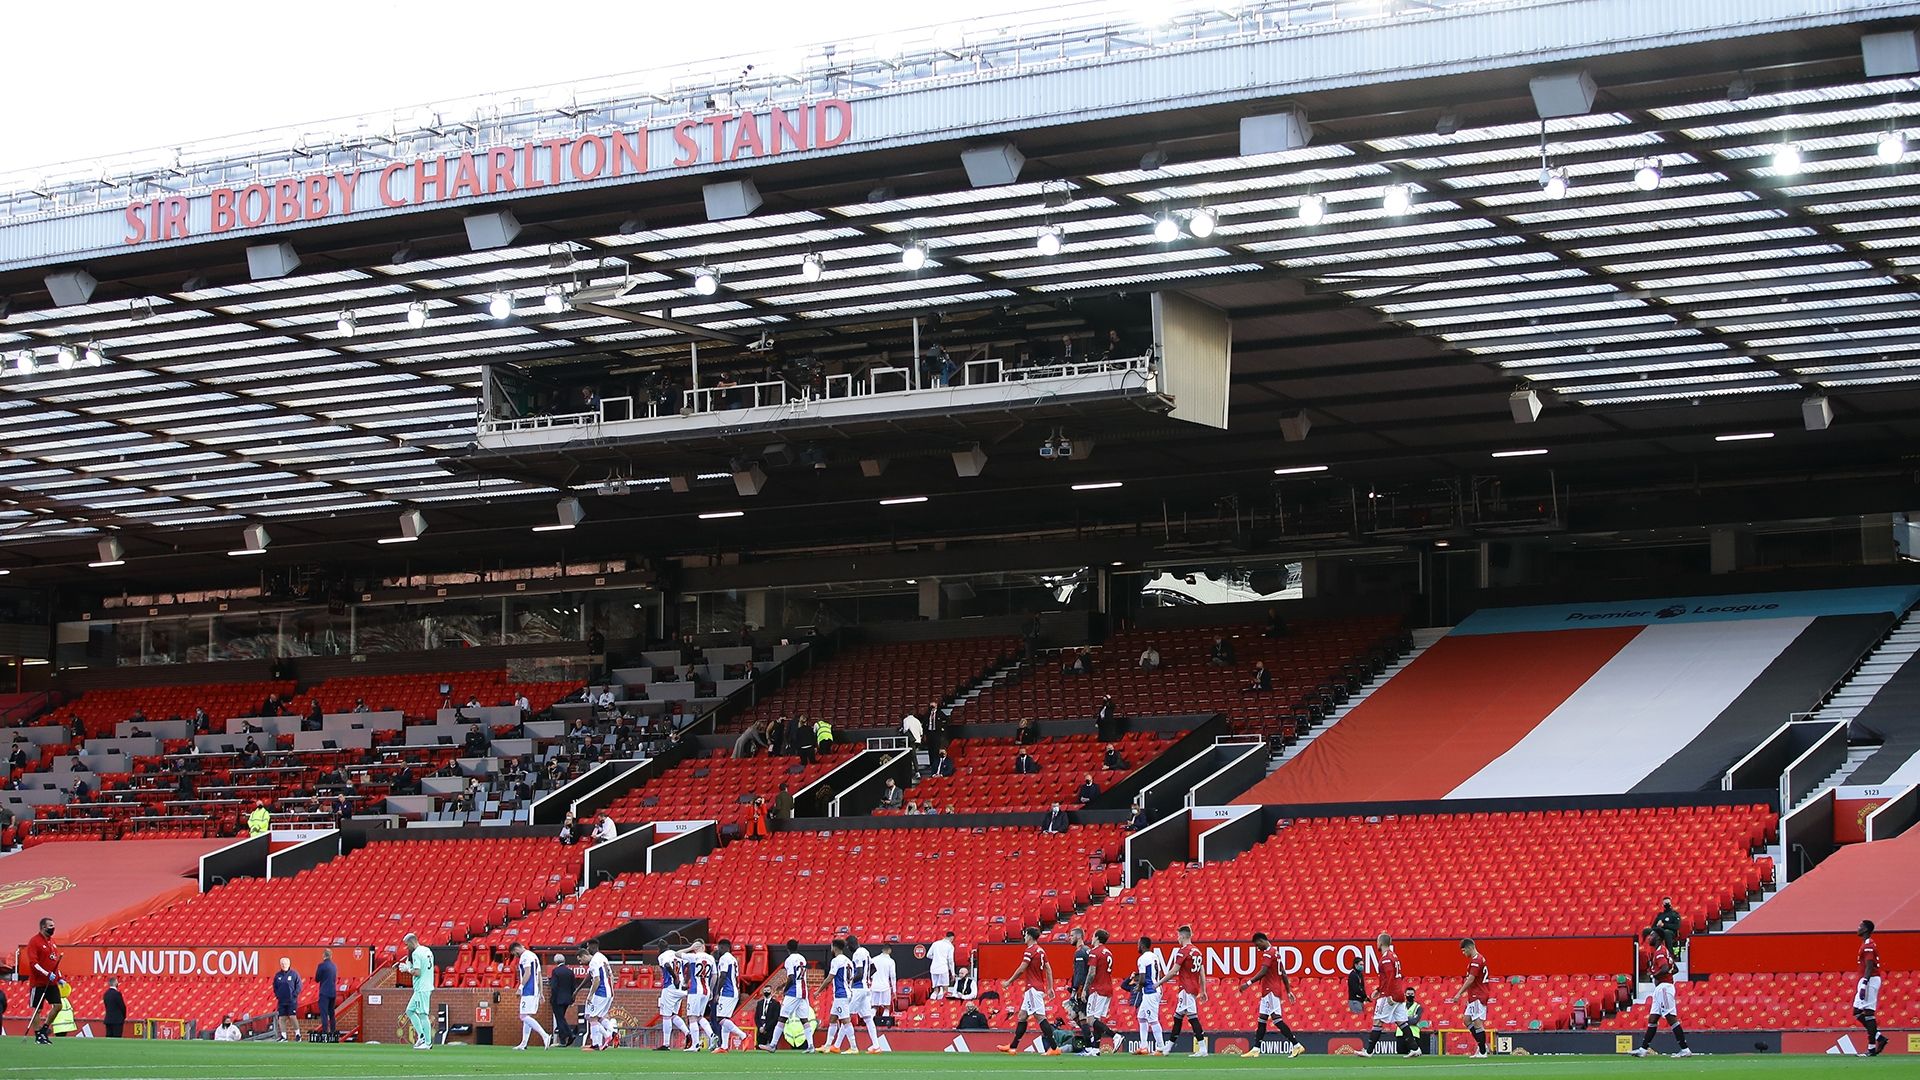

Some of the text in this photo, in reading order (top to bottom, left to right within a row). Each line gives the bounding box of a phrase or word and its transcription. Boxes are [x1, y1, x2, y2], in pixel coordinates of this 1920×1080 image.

[124, 98, 853, 245] SIR BOBBY CHARLTON STAND
[1565, 602, 1780, 621] Premier League
[93, 950, 259, 975] MANUTD.COM
[695, 963, 712, 978] 22
[1106, 955, 1113, 972] 2
[1191, 955, 1203, 973] 39
[1502, 1041, 1508, 1051] 3
